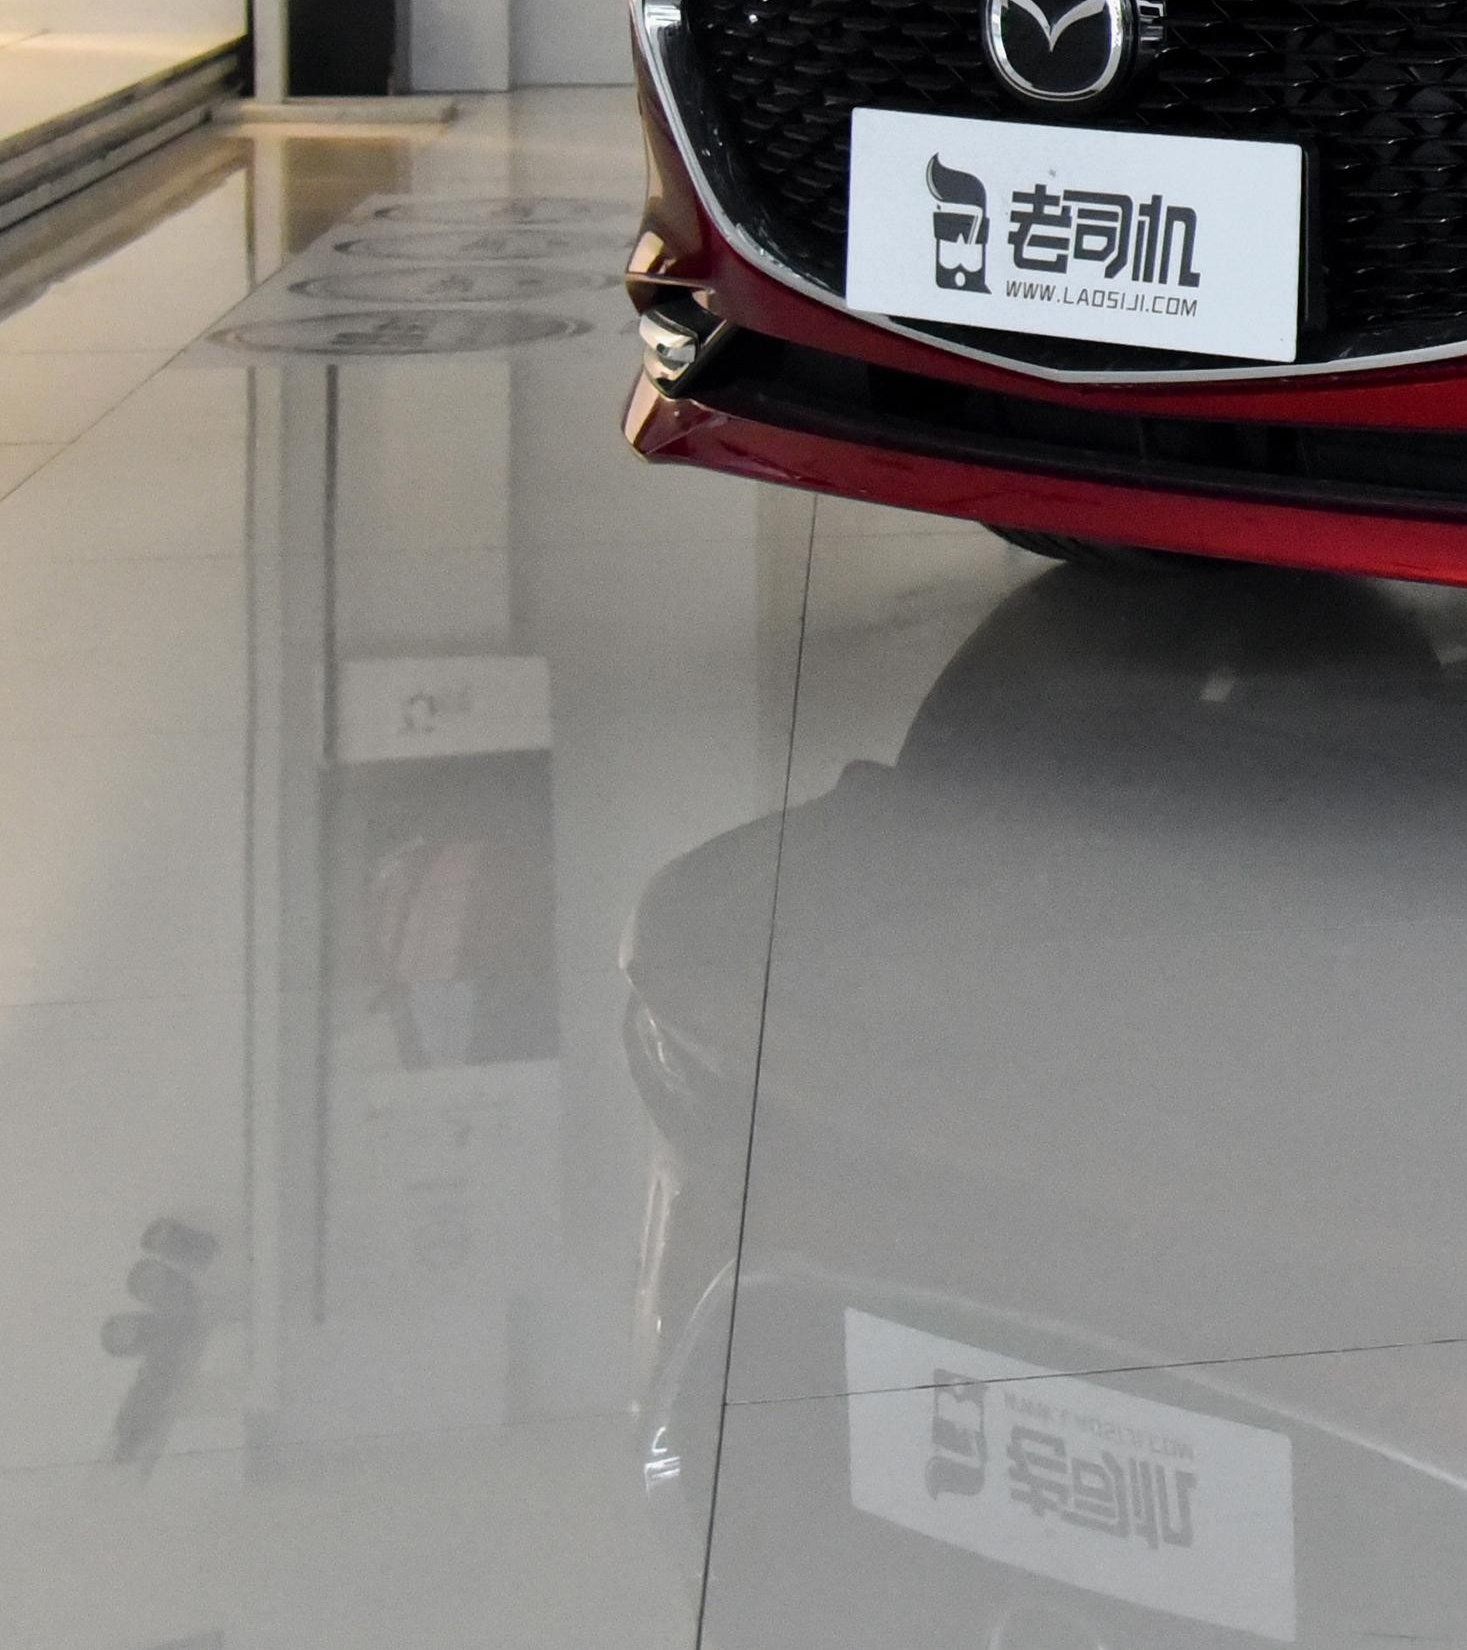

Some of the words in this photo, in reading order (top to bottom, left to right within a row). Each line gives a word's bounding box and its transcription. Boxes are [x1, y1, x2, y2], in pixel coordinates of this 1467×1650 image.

[1008, 184, 1201, 288] 老司机
[1005, 279, 1198, 318] WWW.LAOSIJI.COM
